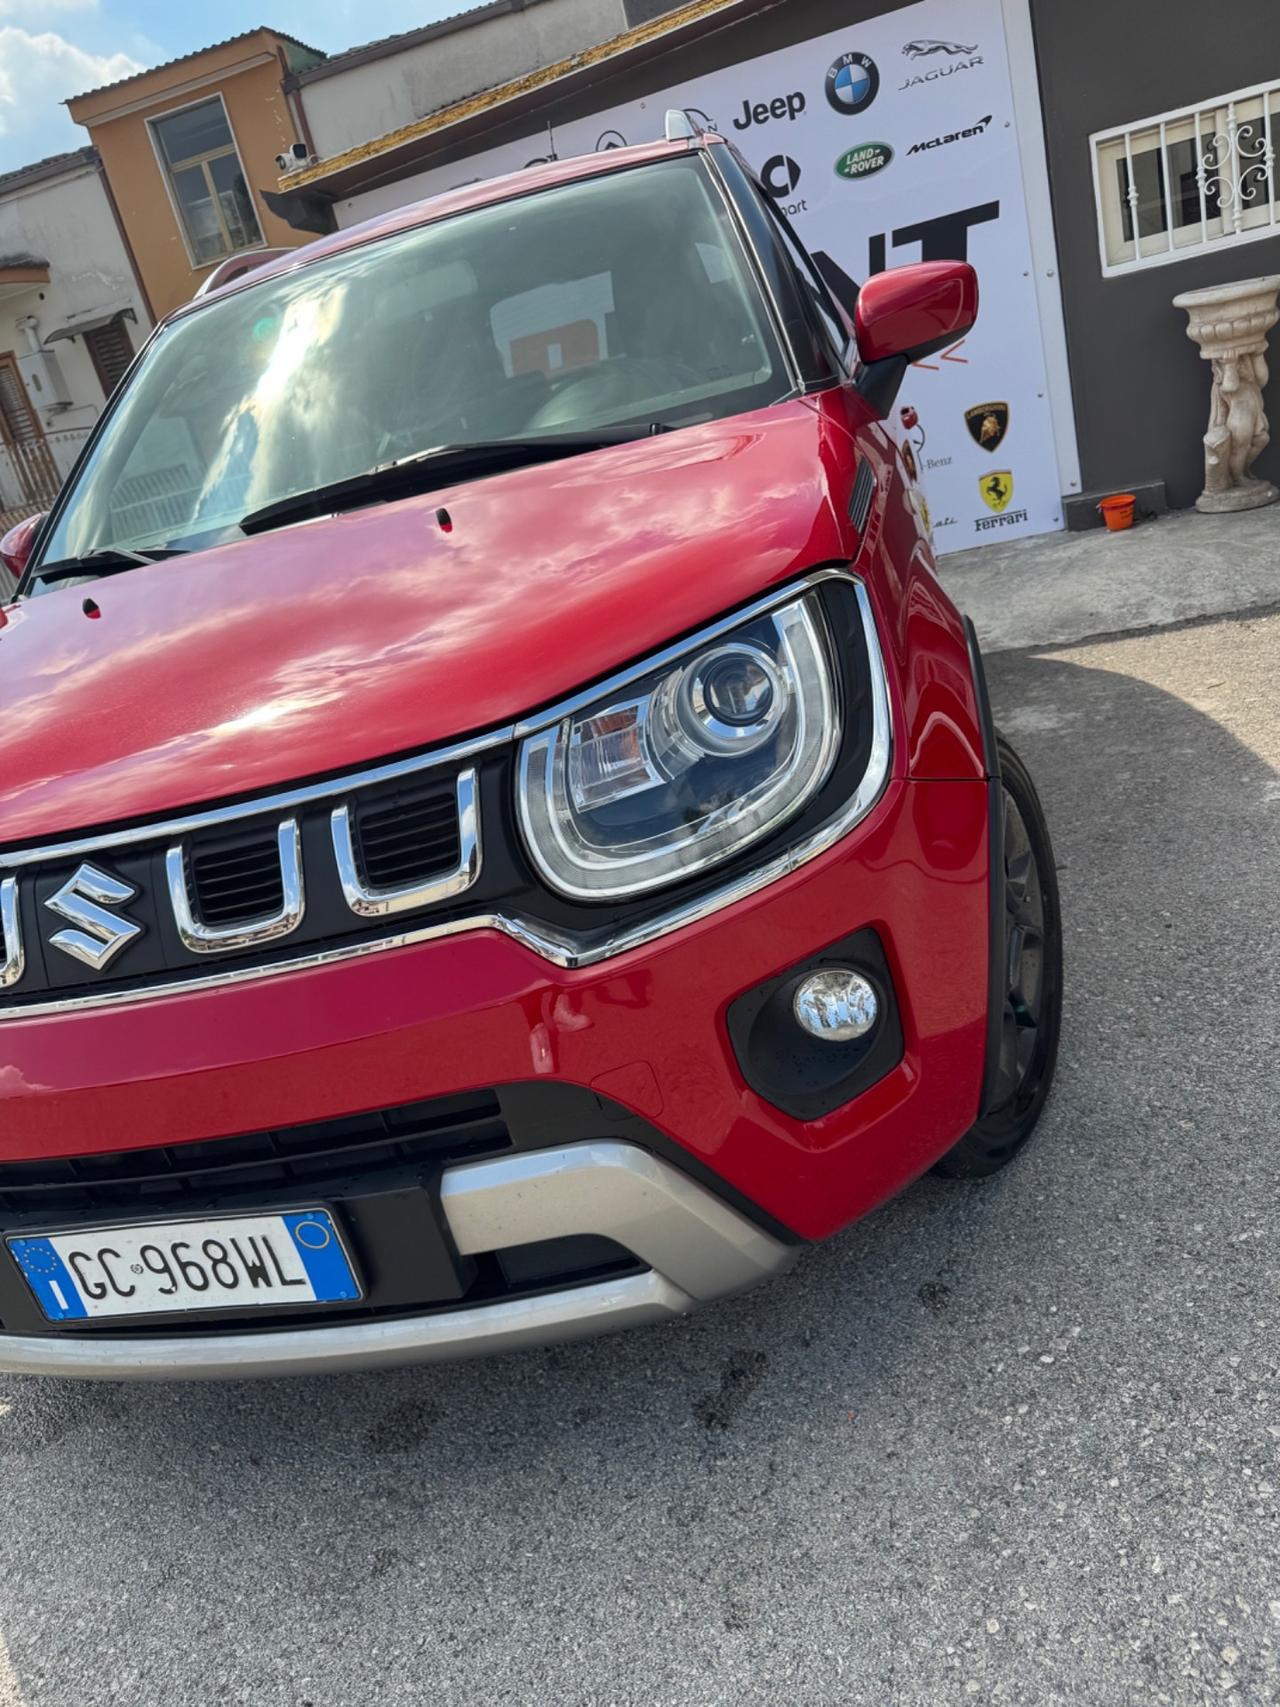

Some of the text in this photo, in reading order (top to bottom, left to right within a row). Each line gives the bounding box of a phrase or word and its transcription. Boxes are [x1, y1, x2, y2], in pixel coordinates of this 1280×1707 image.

[828, 53, 872, 79] BMW
[898, 55, 984, 90] JAGUAR
[732, 91, 805, 130] Jeep
[906, 124, 985, 156] McLaren
[974, 509, 1029, 532] Ferrari
